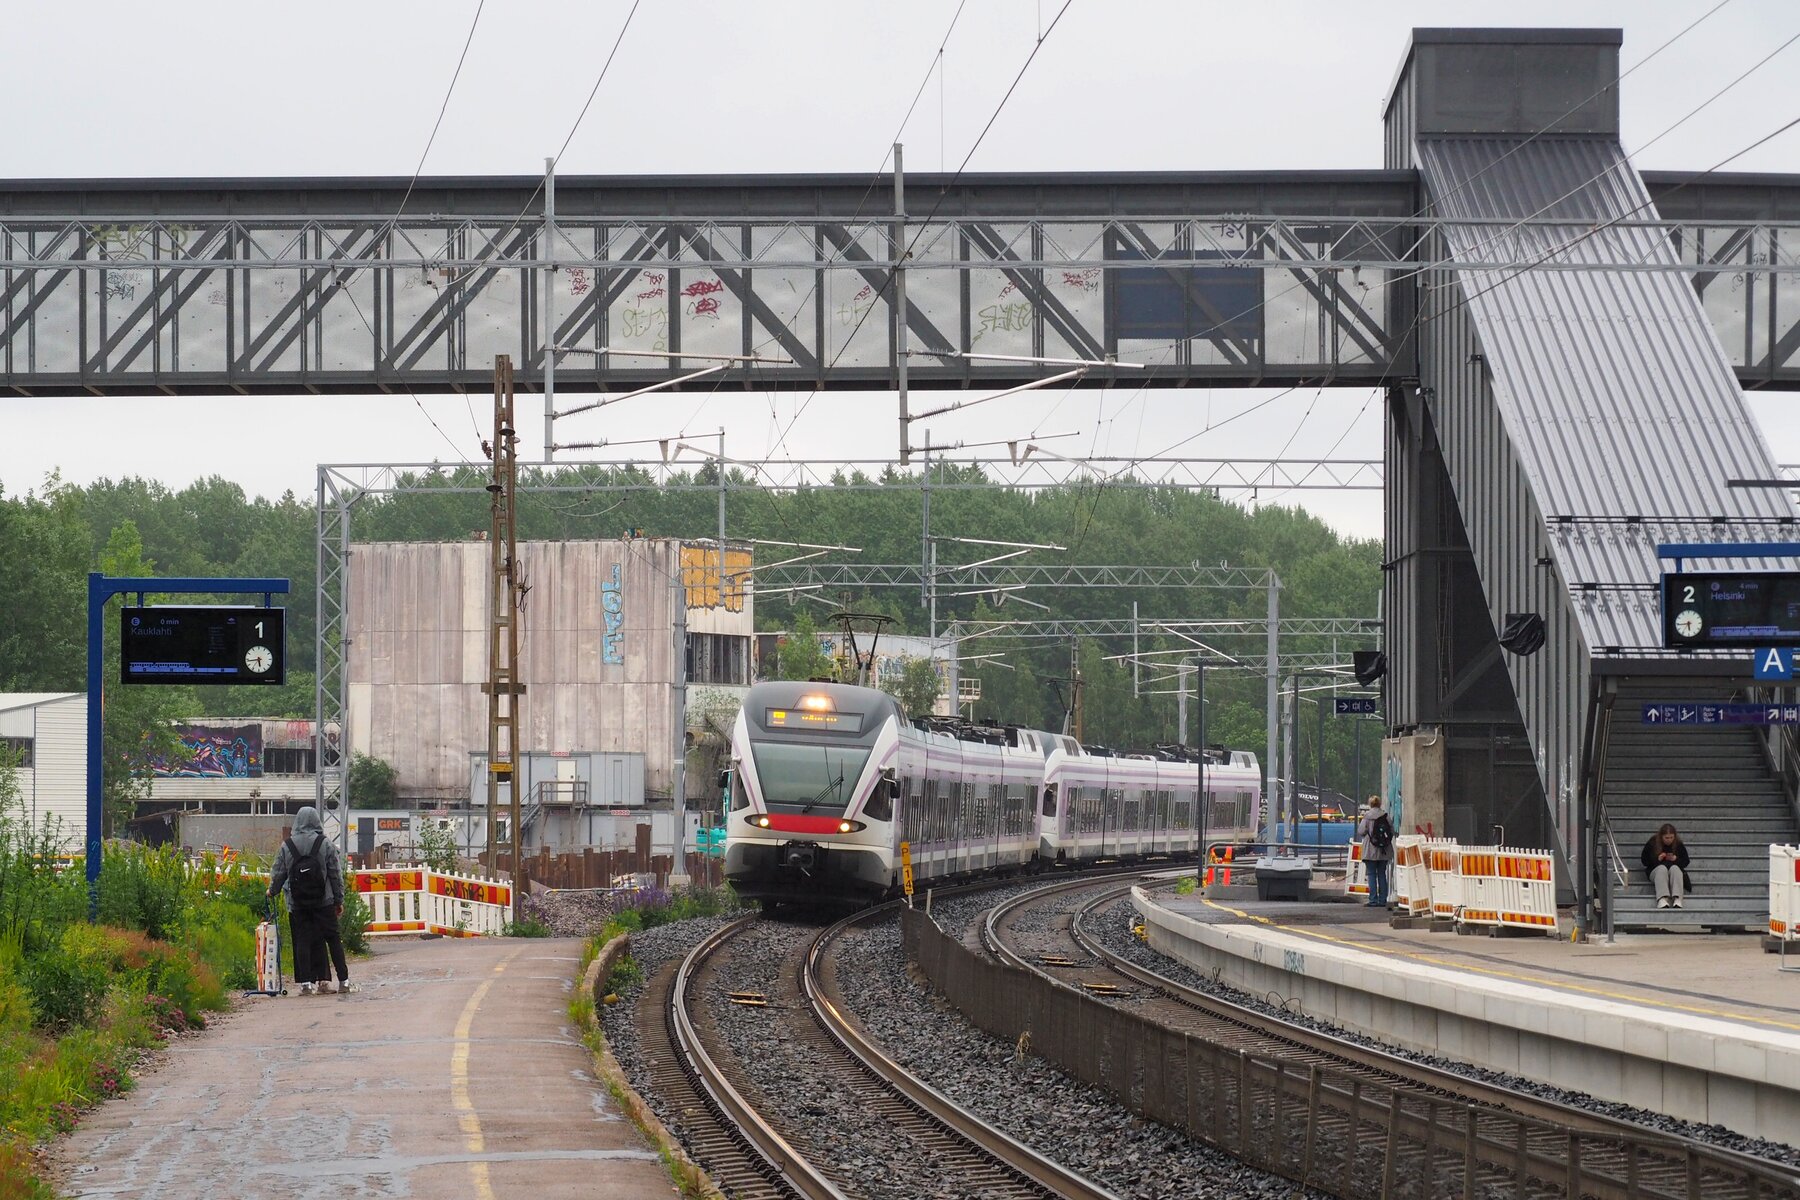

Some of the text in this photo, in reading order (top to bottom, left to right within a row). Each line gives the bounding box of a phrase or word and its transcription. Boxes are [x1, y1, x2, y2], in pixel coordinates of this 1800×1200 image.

[1683, 585, 1695, 603] 2
[1710, 591, 1746, 601] Helsinki
[254, 621, 264, 639] 1
[1762, 648, 1785, 673] A
[1718, 709, 1724, 721] 1
[378, 819, 401, 829] GRK
[901, 847, 909, 857] P
